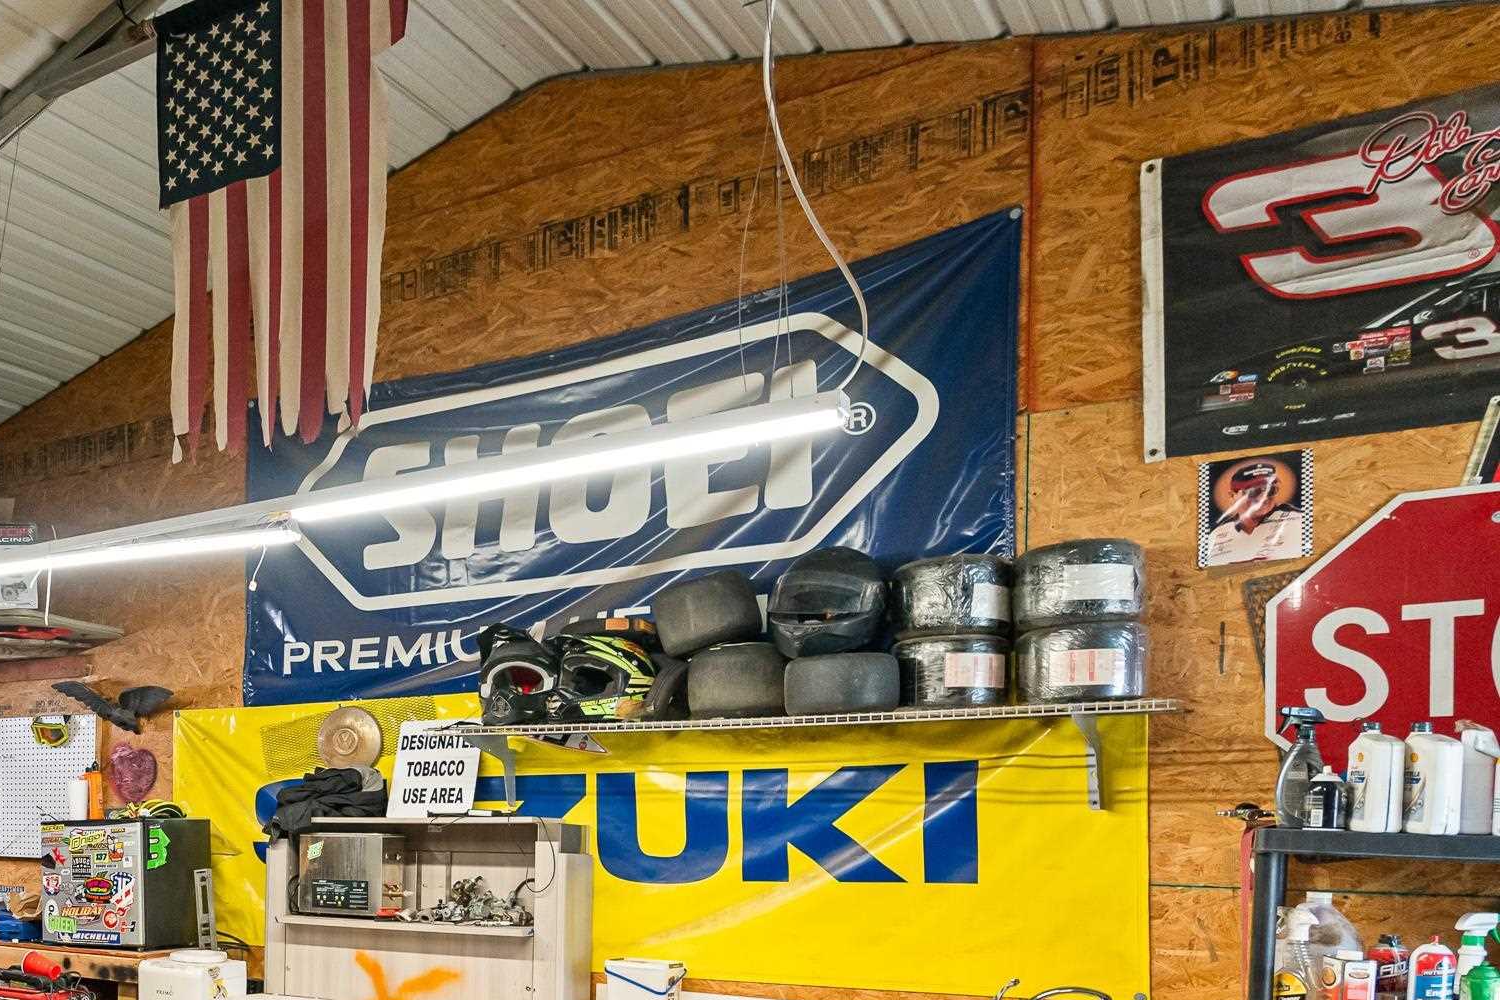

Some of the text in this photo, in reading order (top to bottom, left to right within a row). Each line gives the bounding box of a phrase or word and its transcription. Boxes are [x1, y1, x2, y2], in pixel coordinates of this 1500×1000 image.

[1202, 143, 1500, 299] 3
[362, 358, 818, 571] SHOEI
[1304, 599, 1500, 724] ST
[402, 787, 463, 804] USE AREA
[407, 760, 465, 777] TOBACCO
[72, 932, 118, 941] MICHELIN
